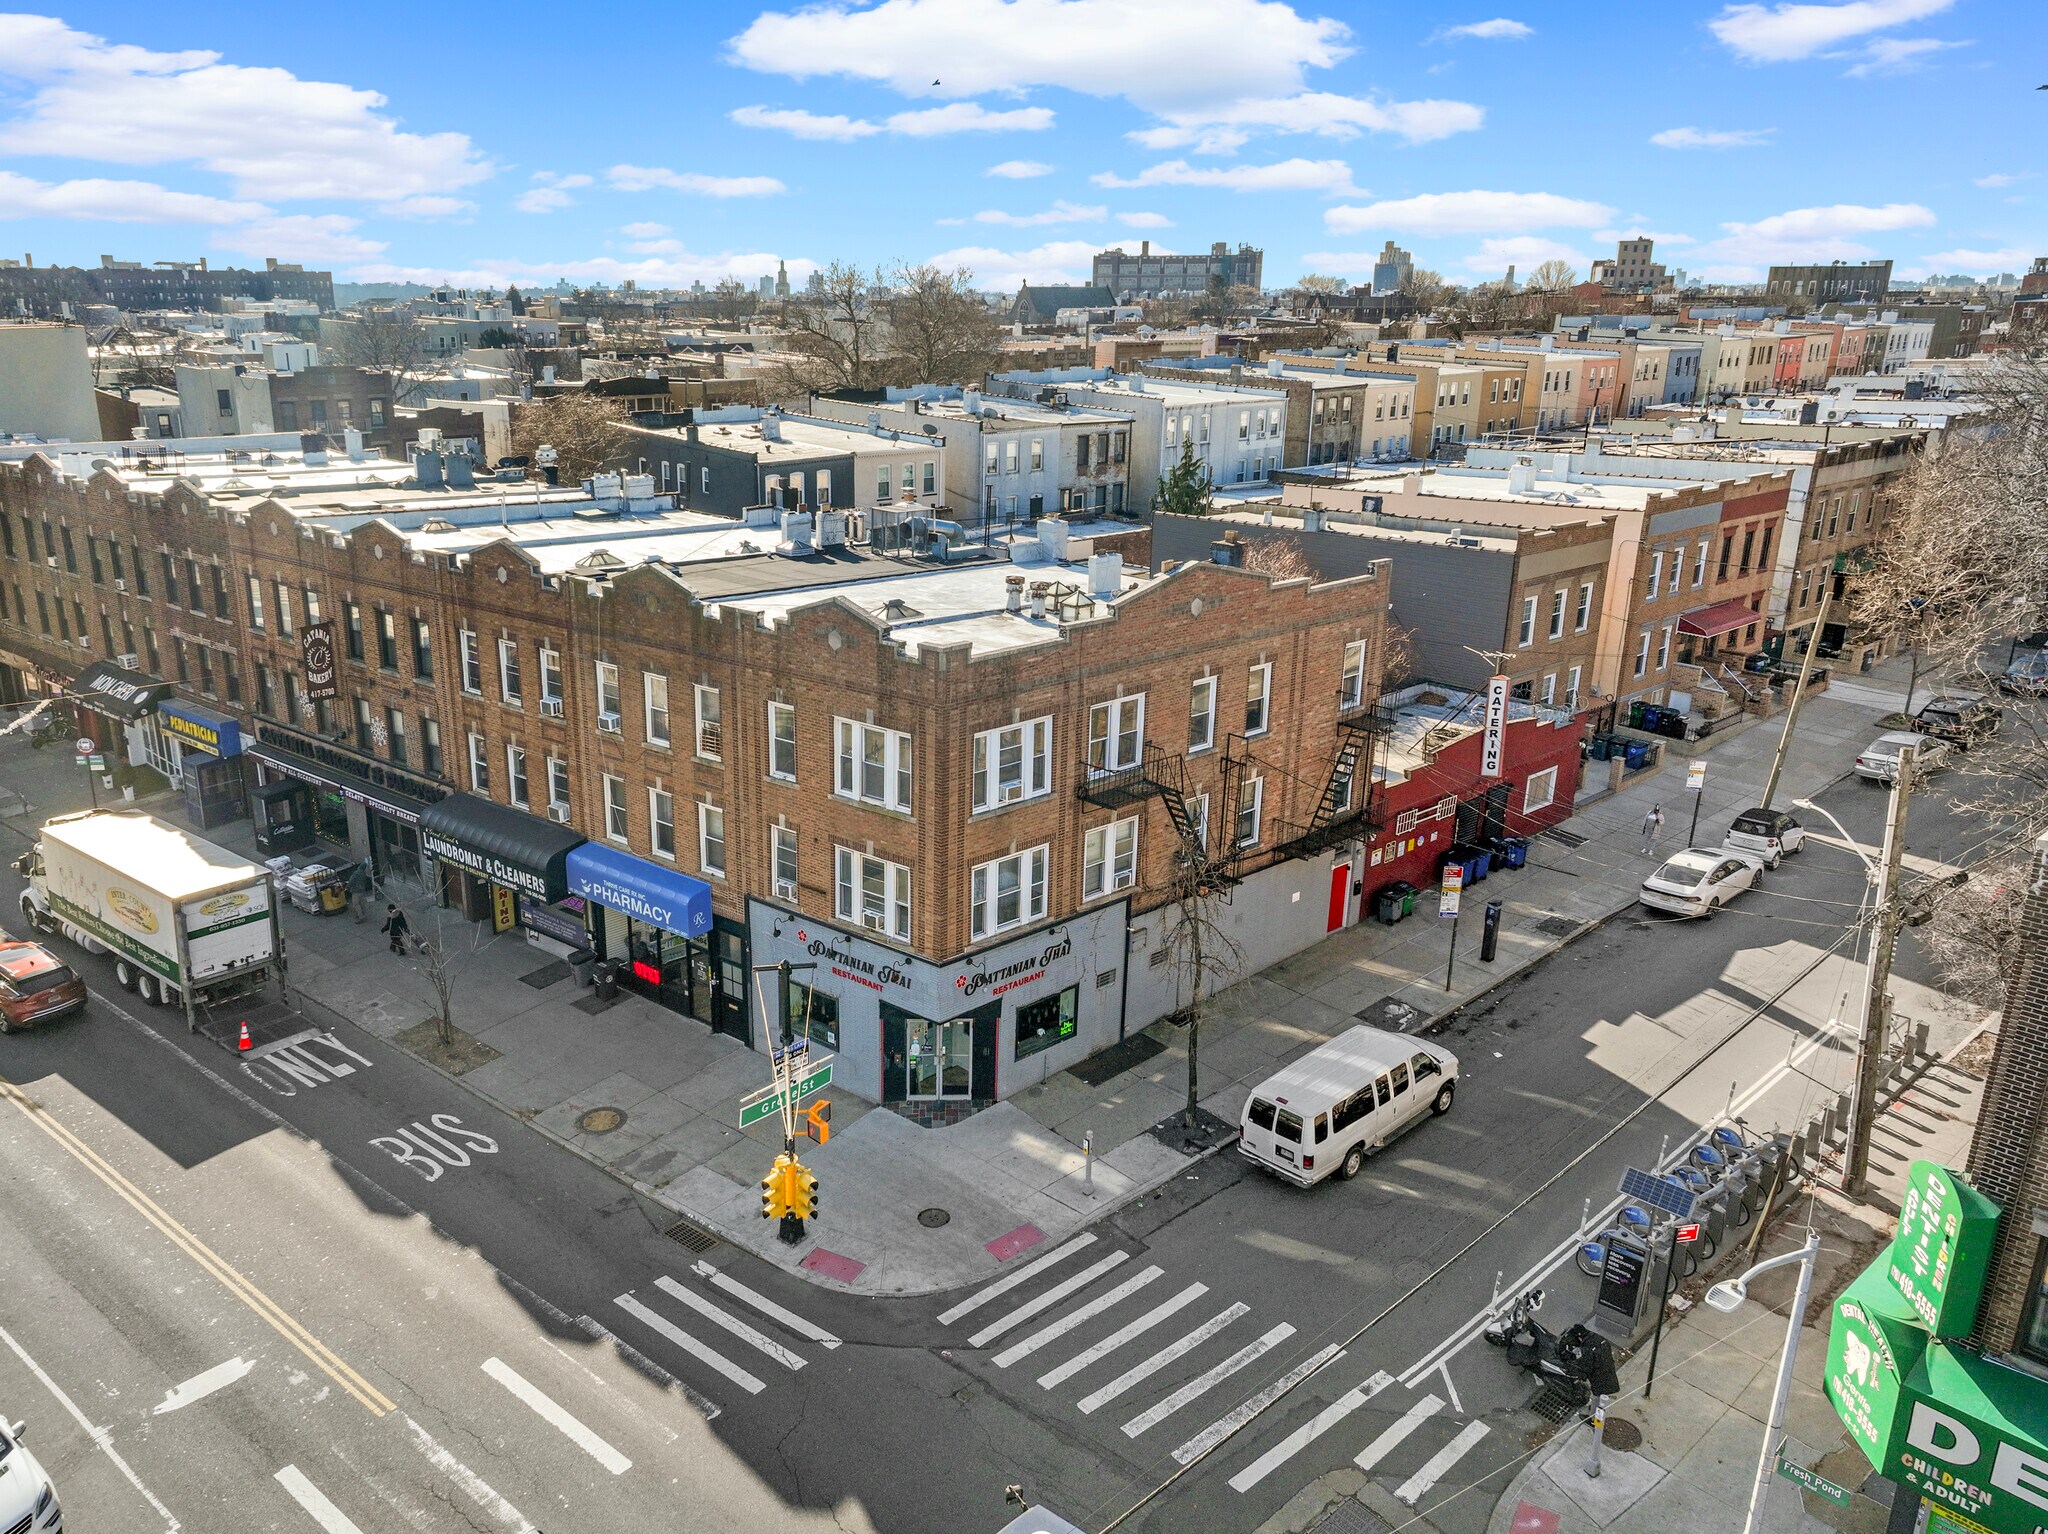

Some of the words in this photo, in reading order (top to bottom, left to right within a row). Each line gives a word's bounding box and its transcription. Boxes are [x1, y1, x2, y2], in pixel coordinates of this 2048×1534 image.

[303, 629, 330, 648] CATANIA
[89, 674, 114, 692] MON
[108, 679, 138, 701] CHERI
[308, 667, 333, 684] BAKERY
[311, 688, 335, 698] 417-5700
[170, 715, 218, 745] PEDIATRICIAN
[1486, 686, 1503, 770] CATERING
[278, 765, 287, 773] FOR
[287, 768, 297, 776] ALL
[296, 772, 322, 786] OCCASIONS
[368, 799, 396, 815] SPECIALTY
[396, 809, 418, 823] BREADS
[423, 832, 482, 870] LAUNDROMAT
[485, 858, 493, 874] &
[494, 860, 546, 894] CLEANERS
[499, 886, 510, 924] NING
[593, 883, 672, 925] PHARMACY
[603, 880, 618, 890] THRIVE
[618, 885, 630, 895] CARE
[807, 940, 875, 975] PATANIAN
[878, 965, 912, 990] TAI
[832, 967, 884, 992] RESTAURANT
[992, 970, 1046, 996] RESTAURANT
[240, 1033, 374, 1096] ONLY
[761, 1090, 797, 1113] Groe
[801, 1080, 815, 1093] St
[367, 1114, 499, 1182] BUS
[1902, 1187, 1919, 1237] ADULT
[1911, 1172, 1946, 1277] DENTIST
[1610, 1250, 1624, 1260] More
[1840, 1303, 1867, 1325] DENTAL
[1899, 1272, 1937, 1327] 418-5555
[1842, 1373, 1871, 1414] Gentle
[1841, 1389, 1878, 1444] 418-5555
[1783, 1462, 1811, 1483] Fresh
[1814, 1478, 1842, 1498] Pond
[1901, 1453, 1993, 1506] CHILDREN
[1906, 1472, 1918, 1484] &
[1922, 1480, 1981, 1514] ADULT
